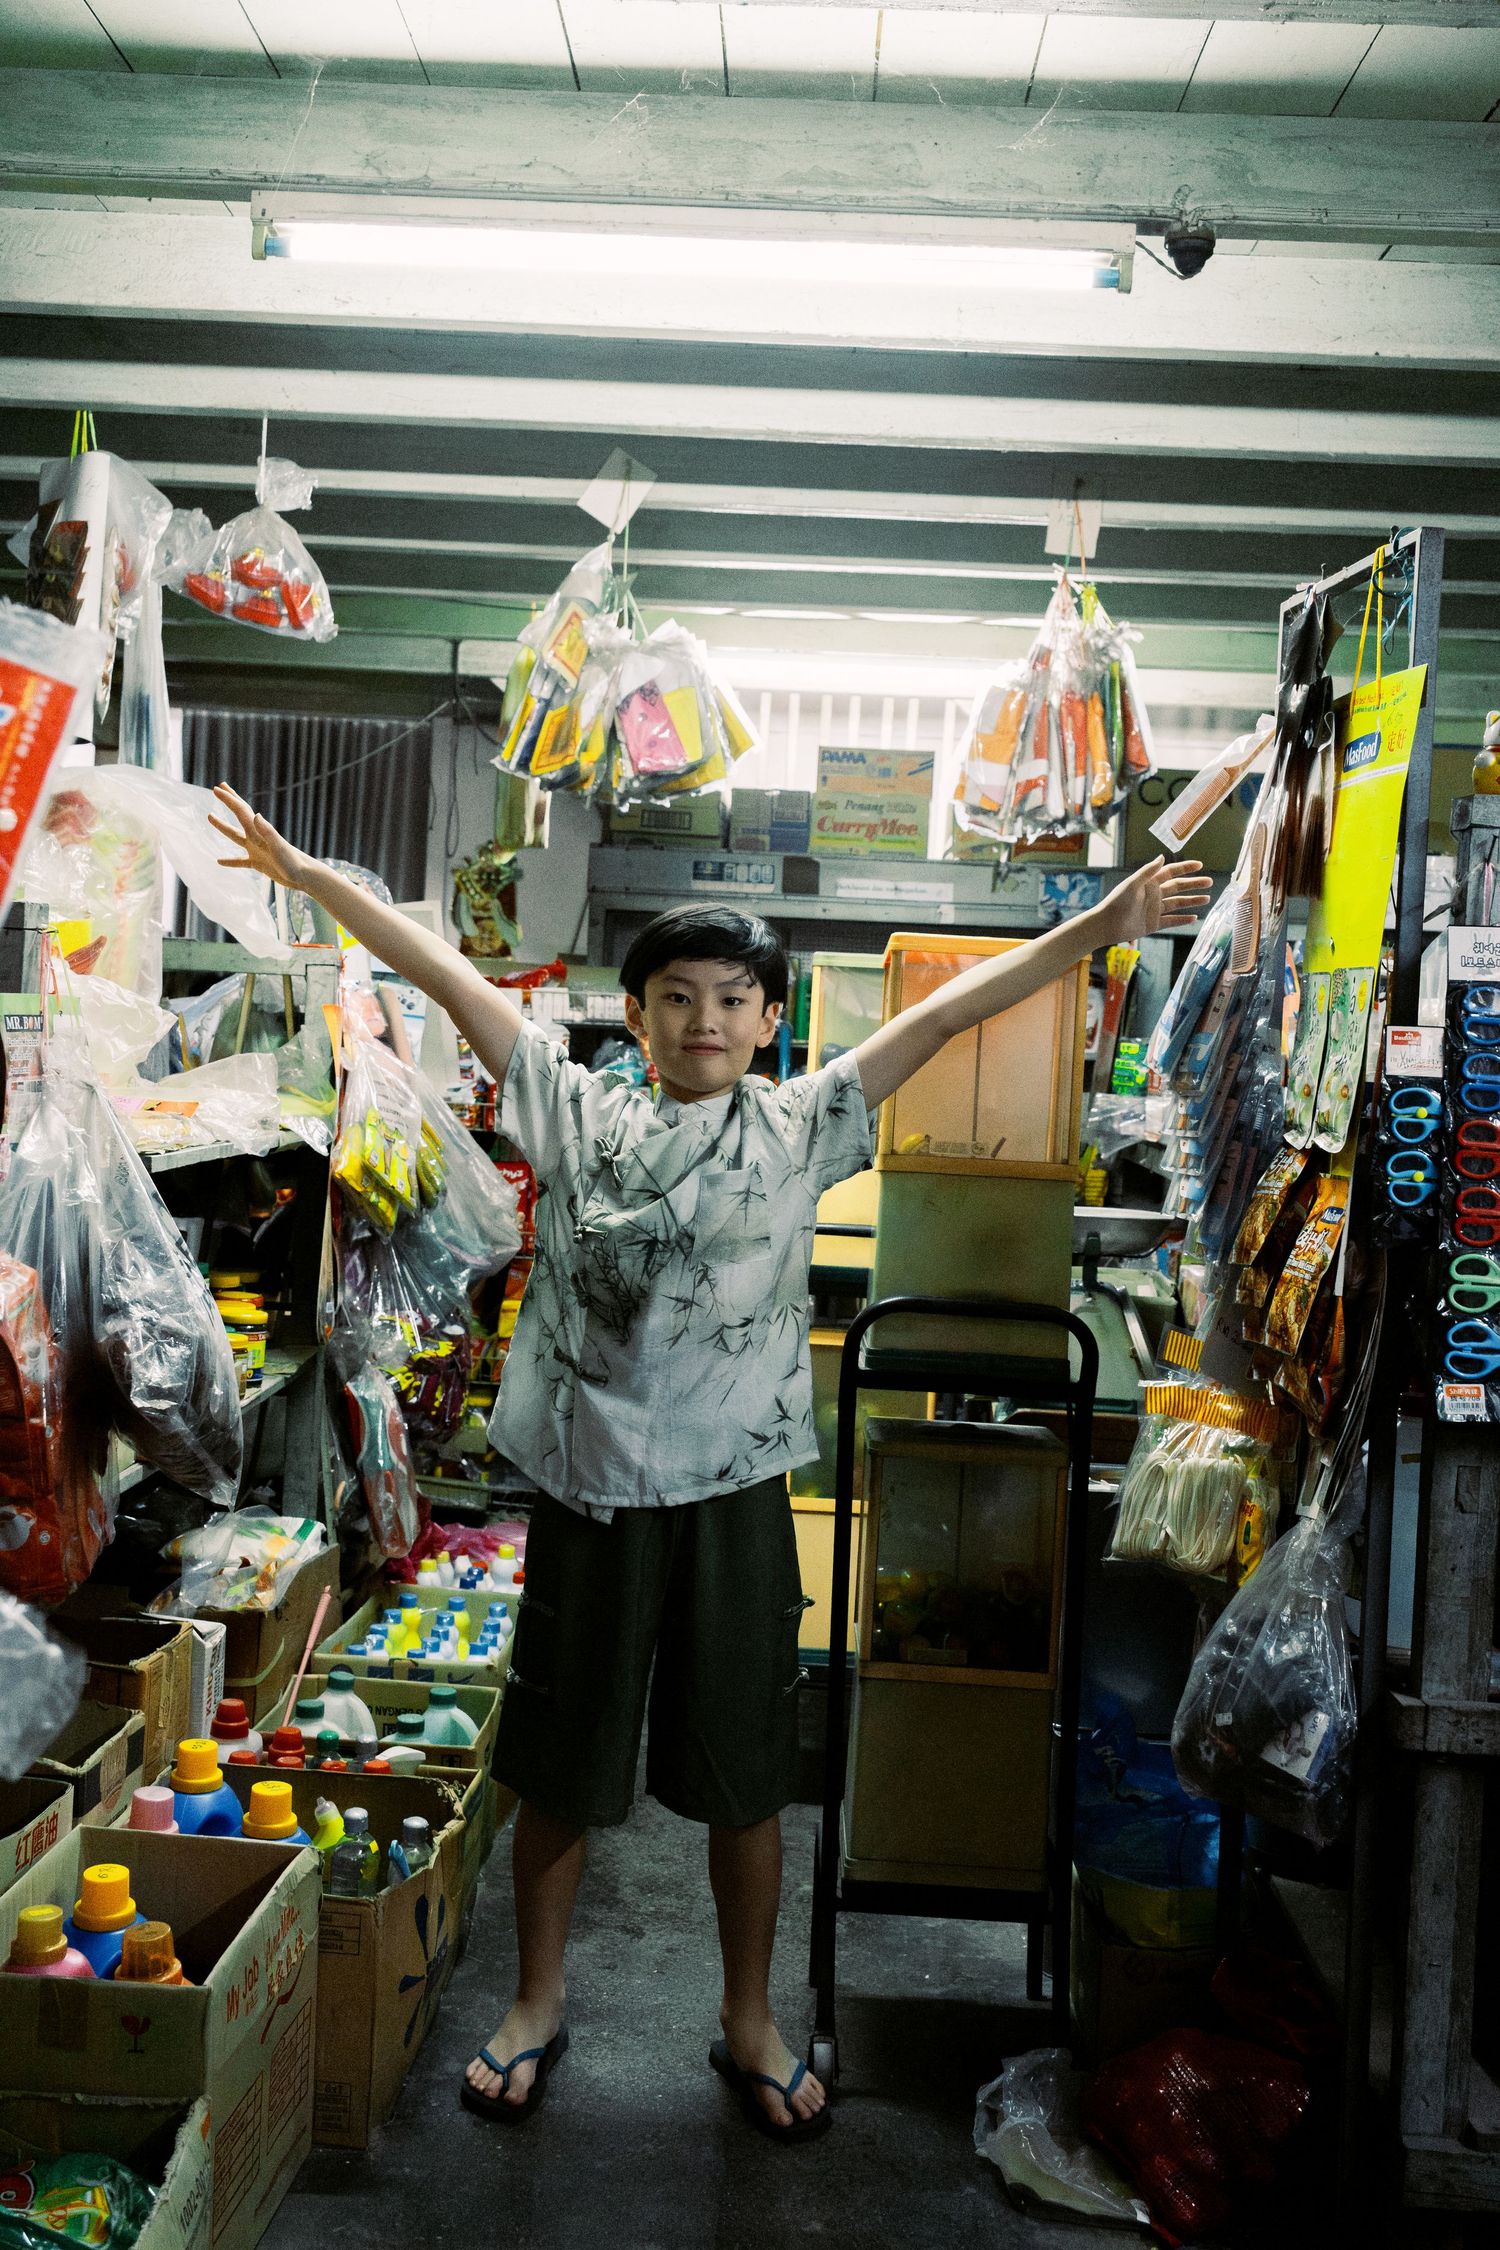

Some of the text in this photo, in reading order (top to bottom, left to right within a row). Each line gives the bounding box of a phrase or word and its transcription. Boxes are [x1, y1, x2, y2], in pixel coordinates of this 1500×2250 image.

[1344, 731, 1379, 767] MasFood
[844, 799, 885, 814] Penang
[816, 816, 879, 842] Curry
[242, 1954, 259, 2000] Job
